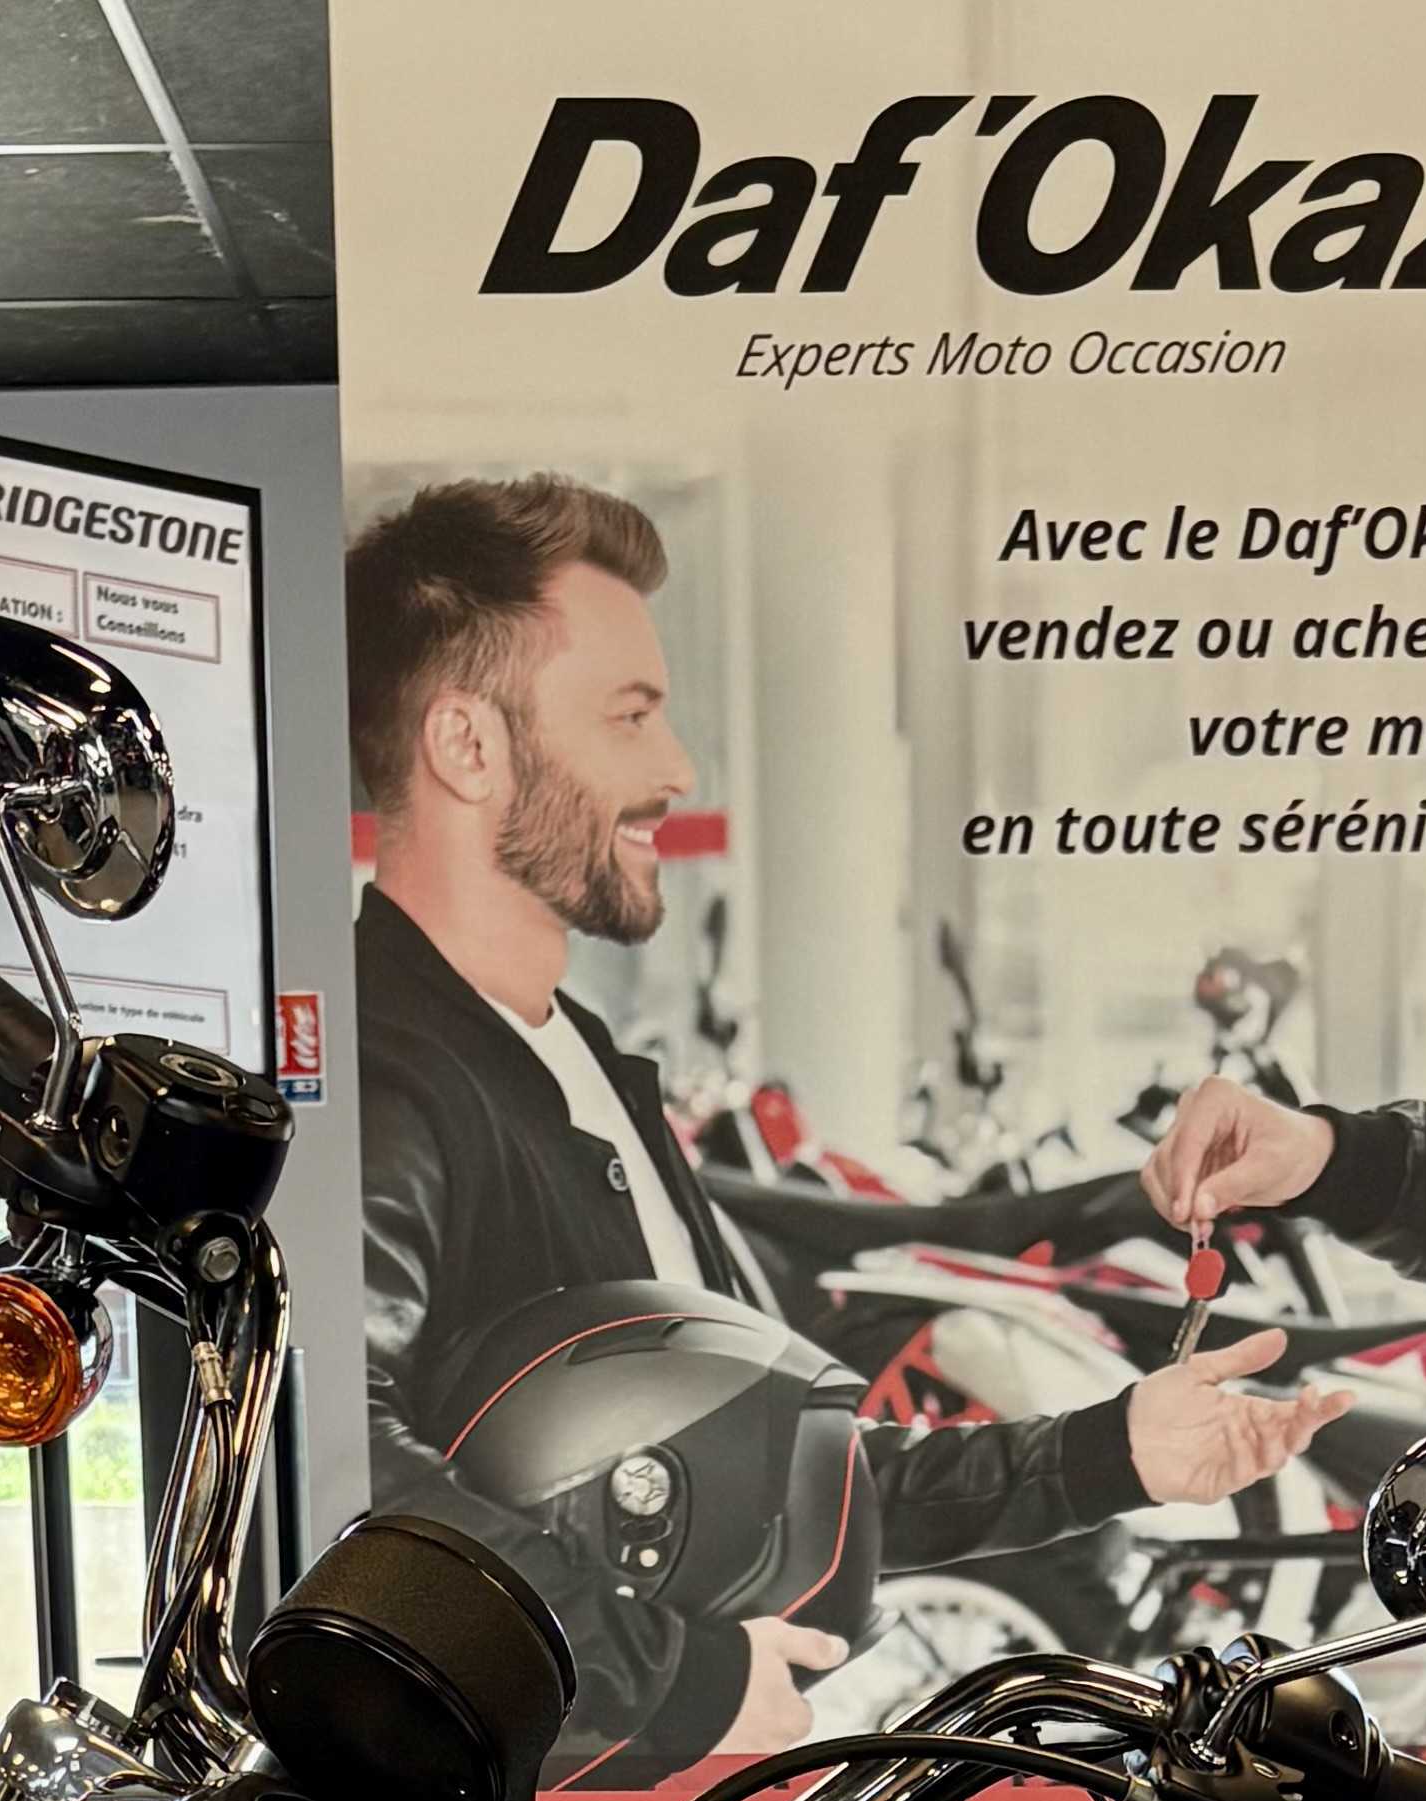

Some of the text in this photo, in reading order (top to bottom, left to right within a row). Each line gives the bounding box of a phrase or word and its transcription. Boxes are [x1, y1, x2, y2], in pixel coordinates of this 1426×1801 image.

[736, 330, 1287, 388] Experts Moto Occasion
[999, 508, 1147, 561] Avec
[1165, 505, 1219, 560] le
[96, 585, 179, 615] Nous vous
[95, 614, 186, 645] Conseillons
[964, 604, 1181, 660] vendez
[1198, 618, 1274, 659] ou
[1189, 709, 1349, 756] votre
[963, 815, 1034, 855] en
[1057, 806, 1221, 854] toute
